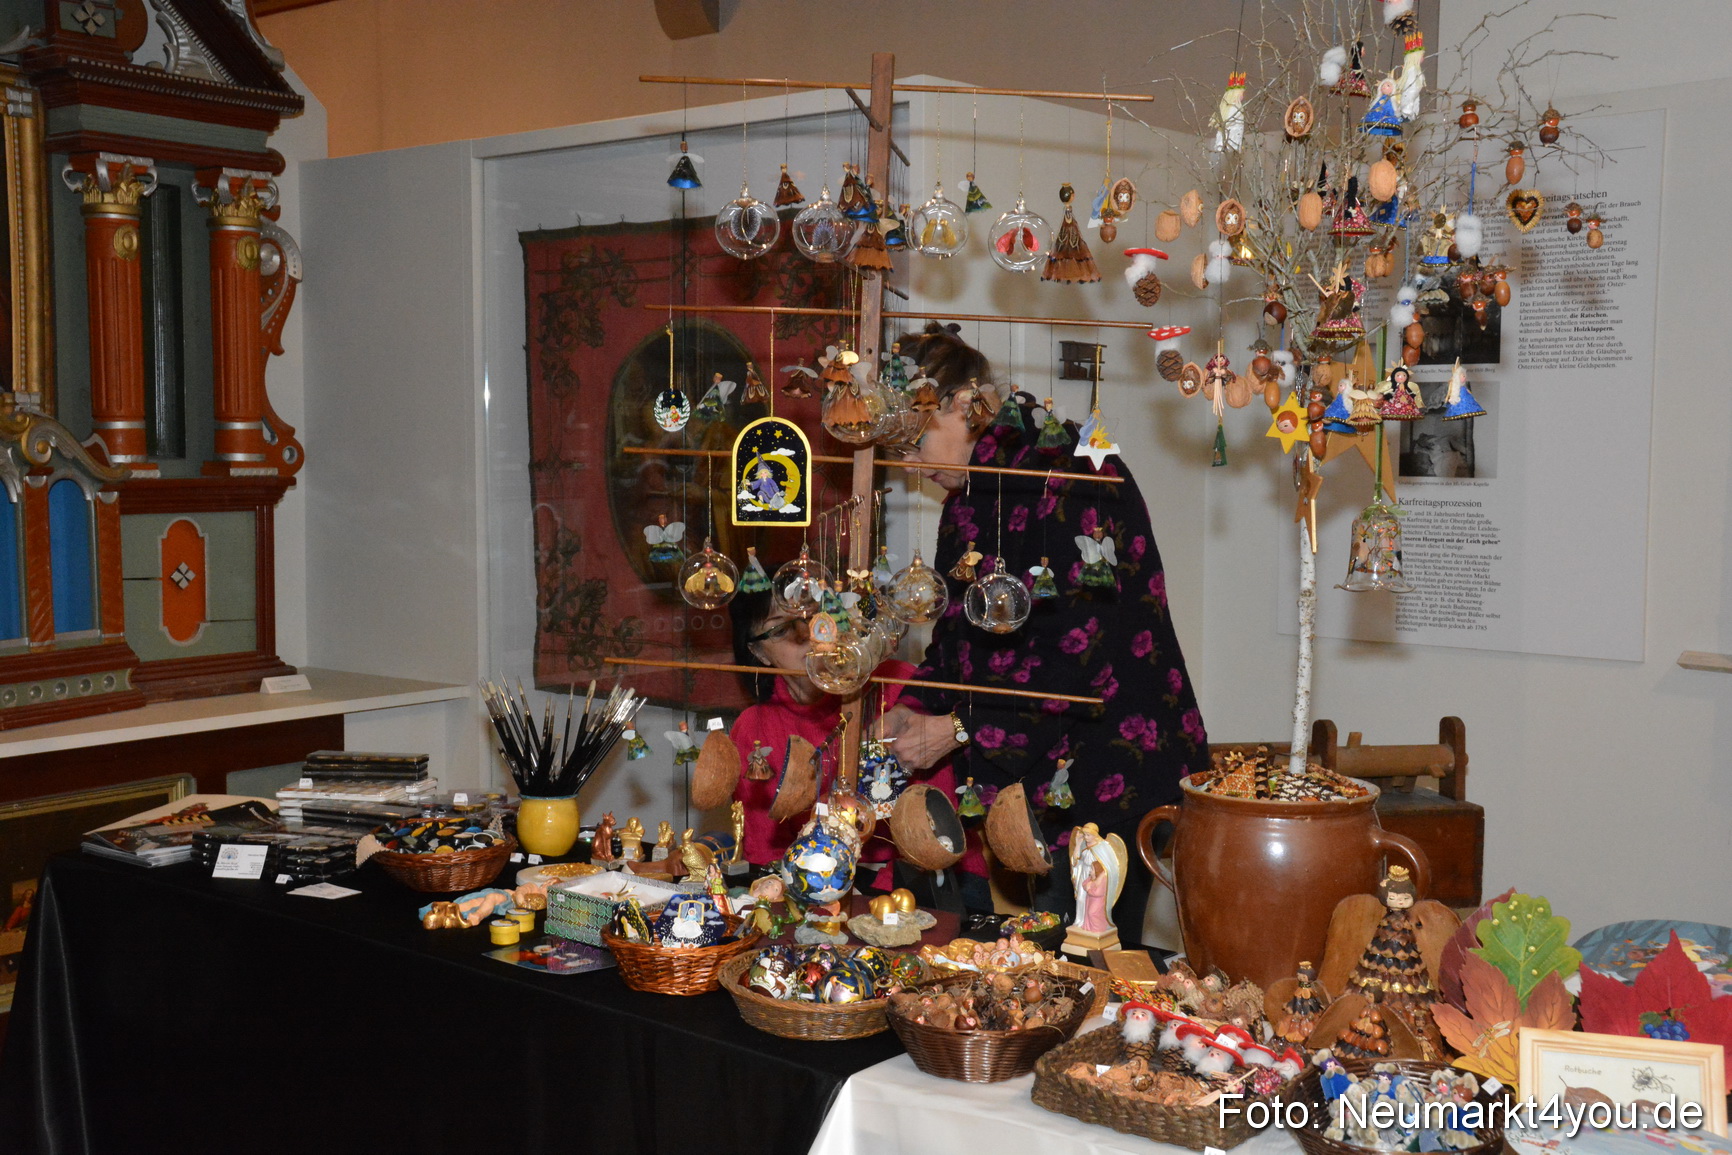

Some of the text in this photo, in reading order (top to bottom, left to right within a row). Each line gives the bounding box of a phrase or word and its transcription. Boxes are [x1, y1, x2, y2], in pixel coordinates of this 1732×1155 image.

[1534, 235, 1565, 243] katholische
[1535, 242, 1567, 250] Nachmittag
[1540, 262, 1563, 270] herrscht
[1564, 261, 1595, 270] symbolisch
[1576, 267, 1609, 275] Volksmund
[1520, 284, 1545, 292] gefahren
[1548, 289, 1585, 297] Auferstehung
[1572, 297, 1614, 305] Gottesdienstes
[1574, 325, 1615, 333] Holzklappern.
[1531, 356, 1560, 364] Kirchgang
[1398, 497, 1482, 508] Karfreitagsprozession
[1407, 515, 1432, 524] Karfreitag
[1450, 517, 1476, 525] Oberpfalz
[1478, 518, 1492, 526] große
[1422, 535, 1444, 543] Herrgott
[1444, 589, 1464, 597] lebende
[1429, 601, 1438, 609] gab
[1564, 1065, 1602, 1076] Rotbuche
